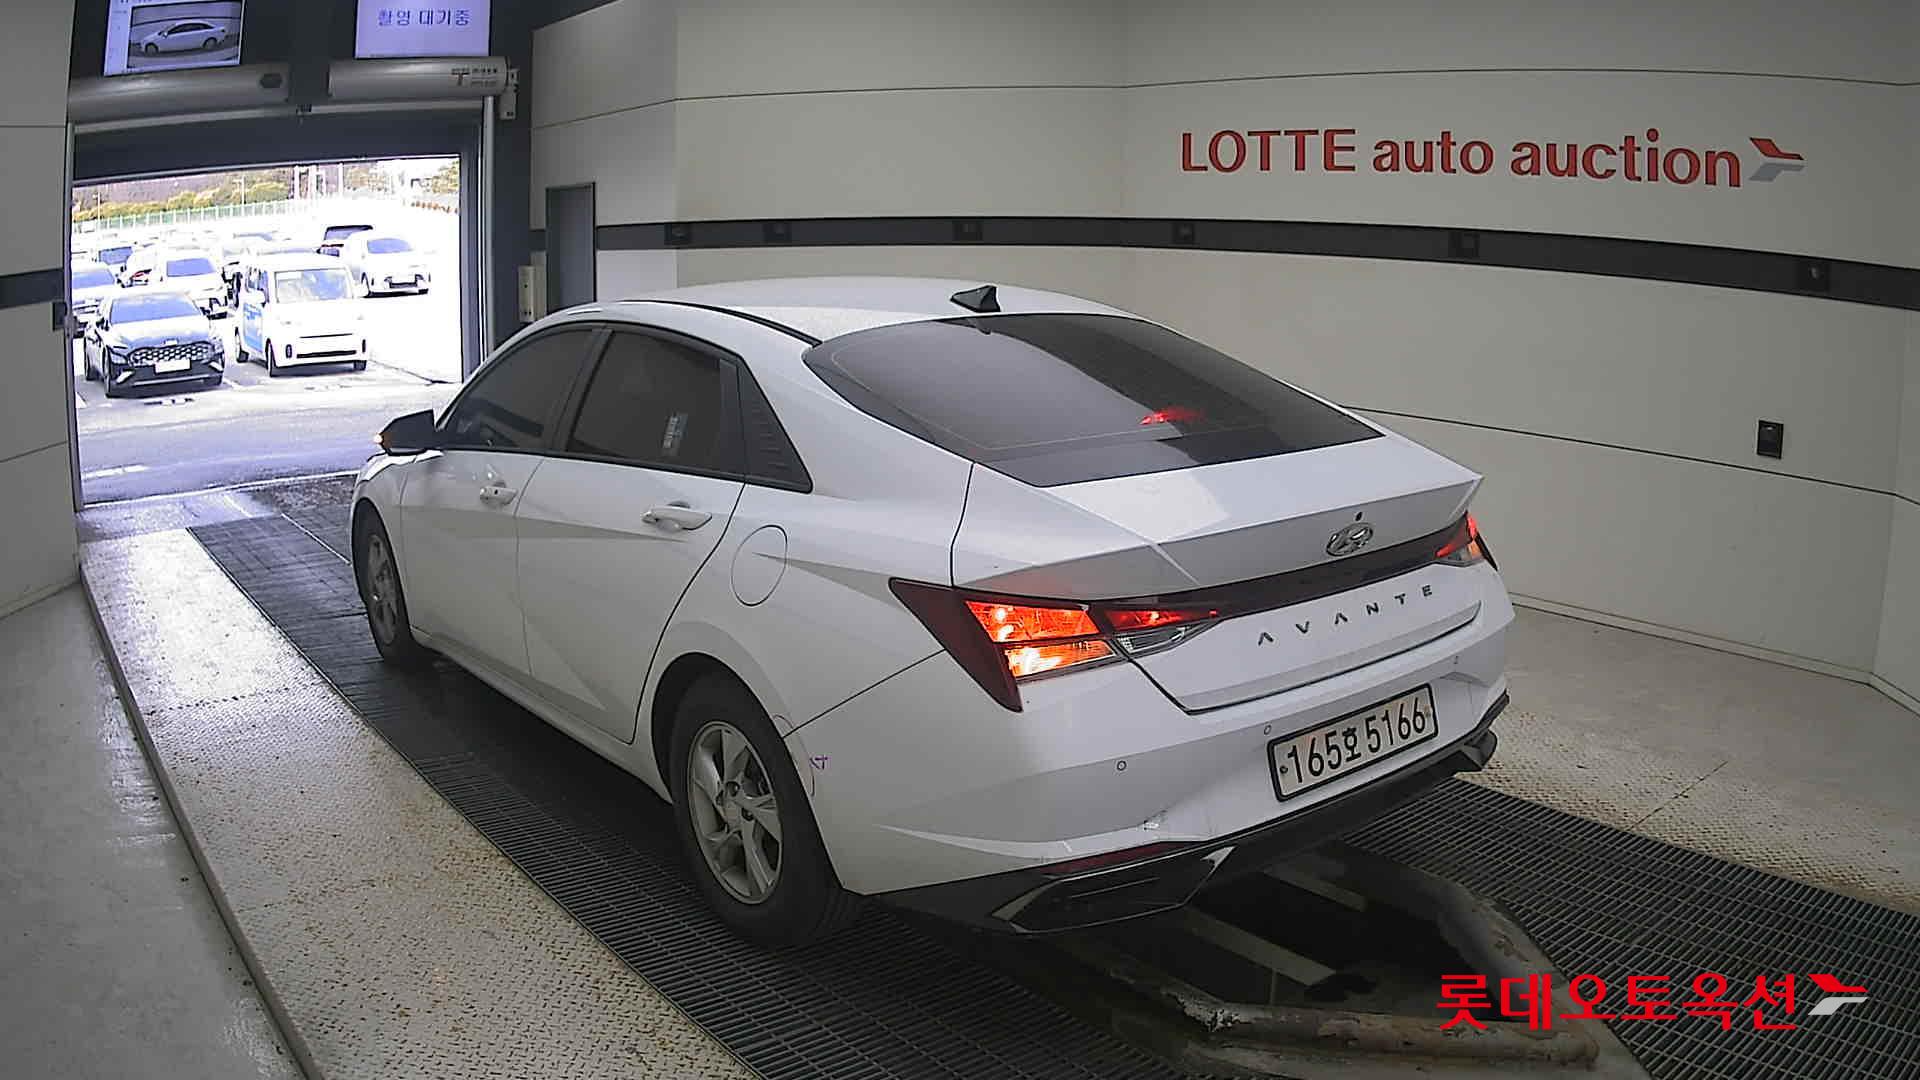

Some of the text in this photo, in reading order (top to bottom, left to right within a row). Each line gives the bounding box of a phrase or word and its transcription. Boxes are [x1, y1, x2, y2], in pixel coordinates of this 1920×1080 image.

[419, 8, 471, 27] 대기중
[1180, 128, 1742, 188] LOTTE auto auction
[1257, 584, 1433, 646] AVANTE
